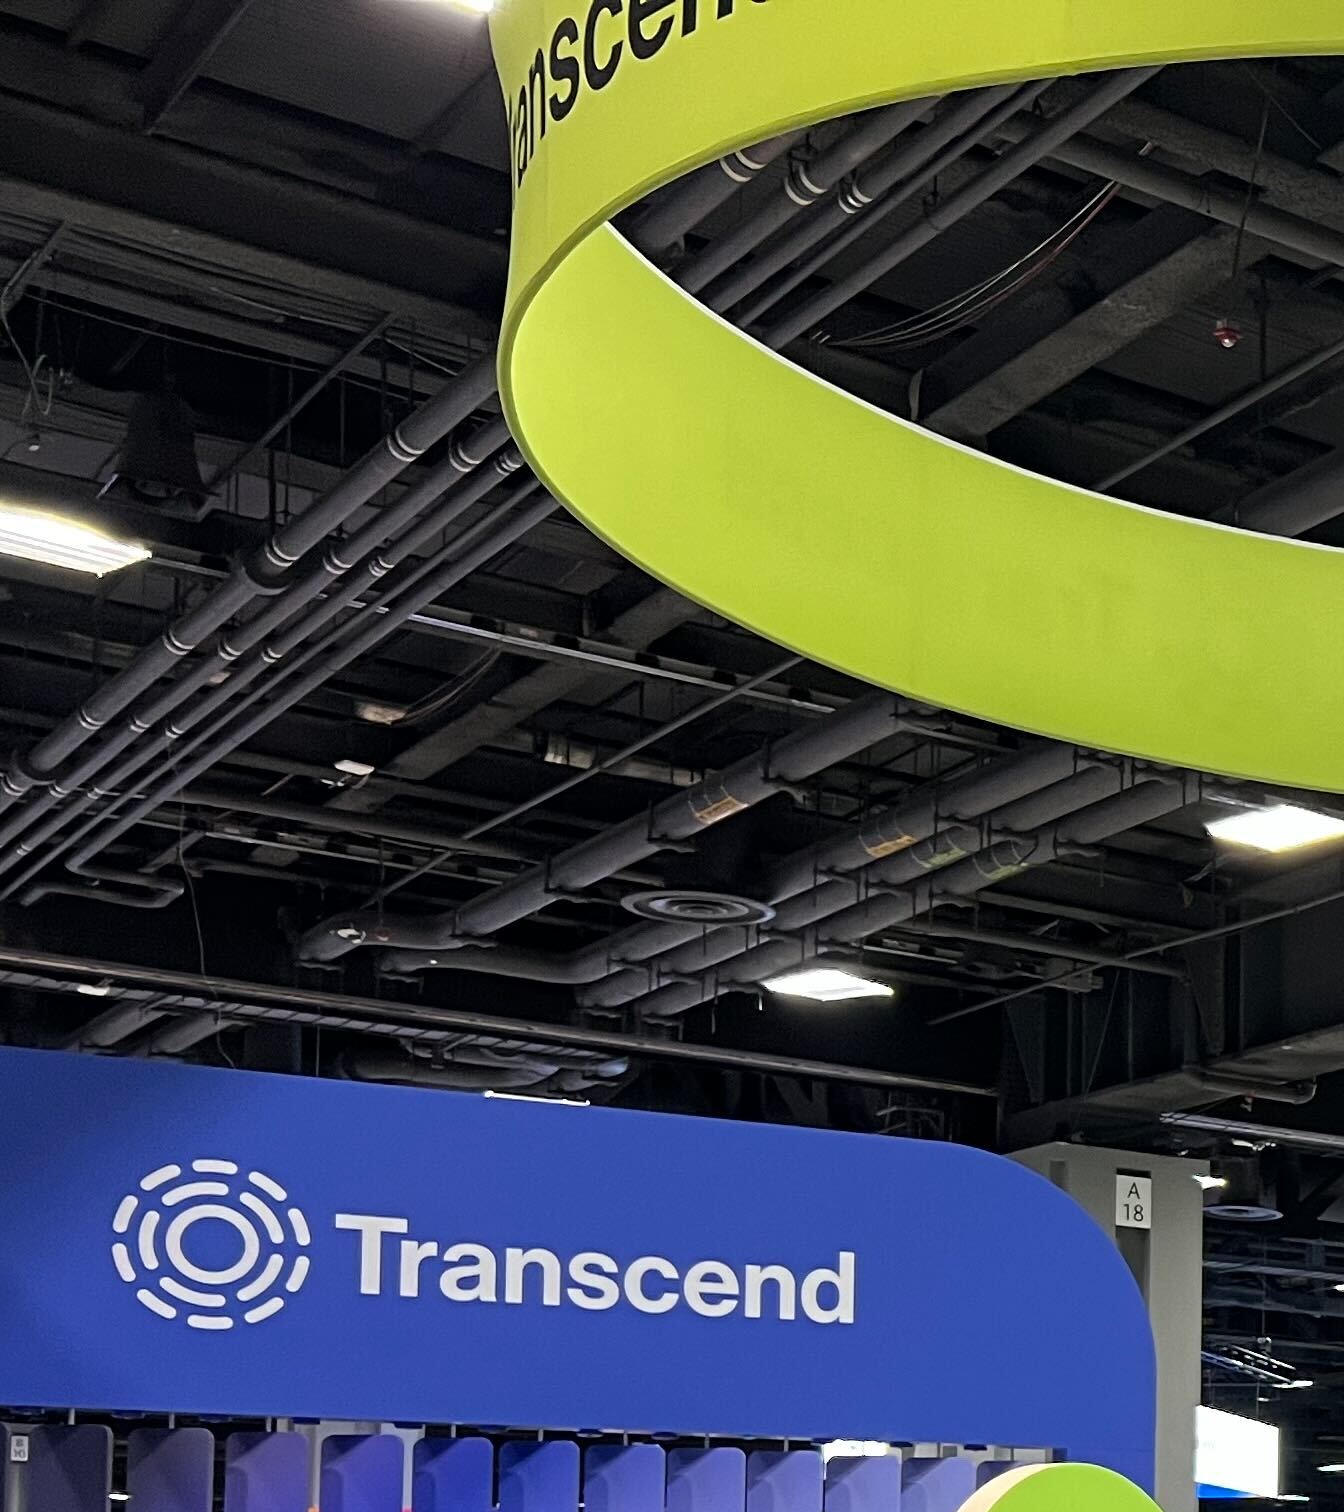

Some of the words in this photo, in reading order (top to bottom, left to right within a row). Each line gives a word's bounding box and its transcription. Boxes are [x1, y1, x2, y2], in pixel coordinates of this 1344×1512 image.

[1127, 1182, 1141, 1200] A
[1123, 1203, 1144, 1222] 18
[335, 1213, 855, 1324] Transcend
